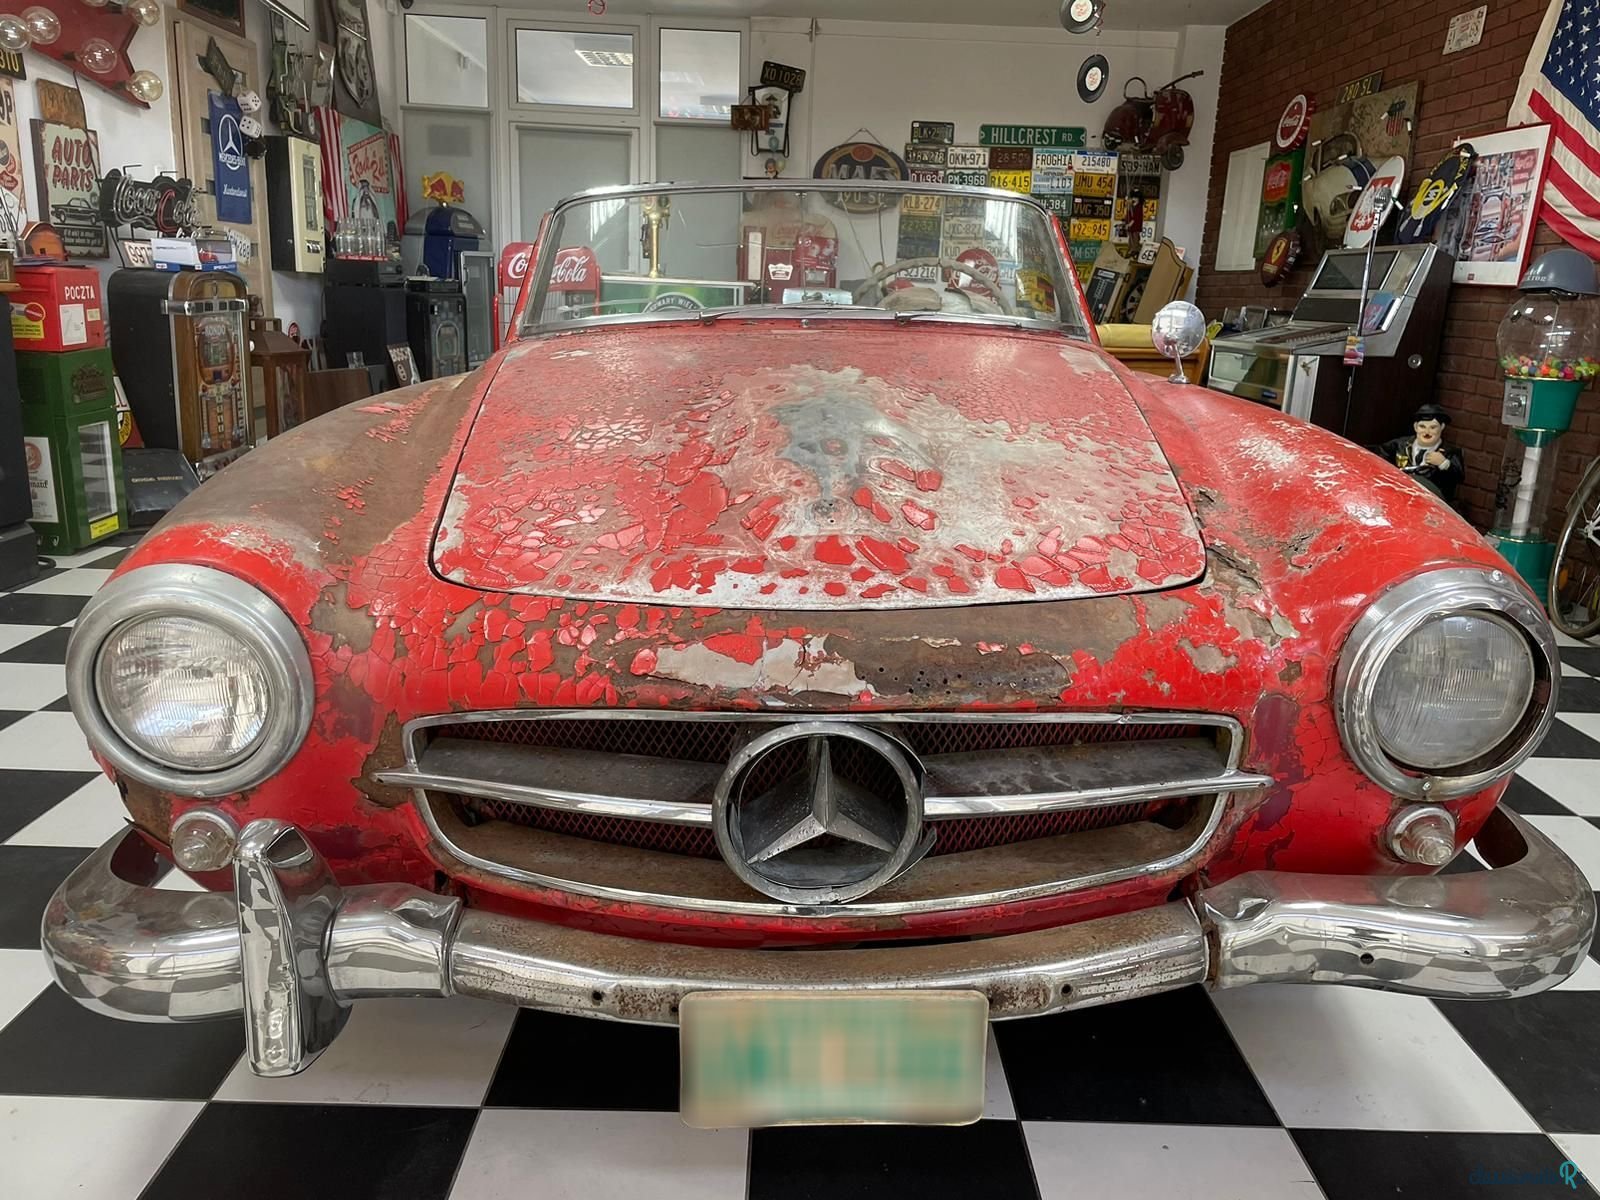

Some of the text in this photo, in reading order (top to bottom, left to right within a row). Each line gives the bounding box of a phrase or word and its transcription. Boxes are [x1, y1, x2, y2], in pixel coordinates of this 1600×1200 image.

[991, 128, 1057, 145] HILLCREST
[52, 135, 92, 168] AUTO
[1035, 153, 1073, 166] FROGHIA
[53, 164, 94, 192] PARTS
[65, 285, 96, 300] POCZTA
